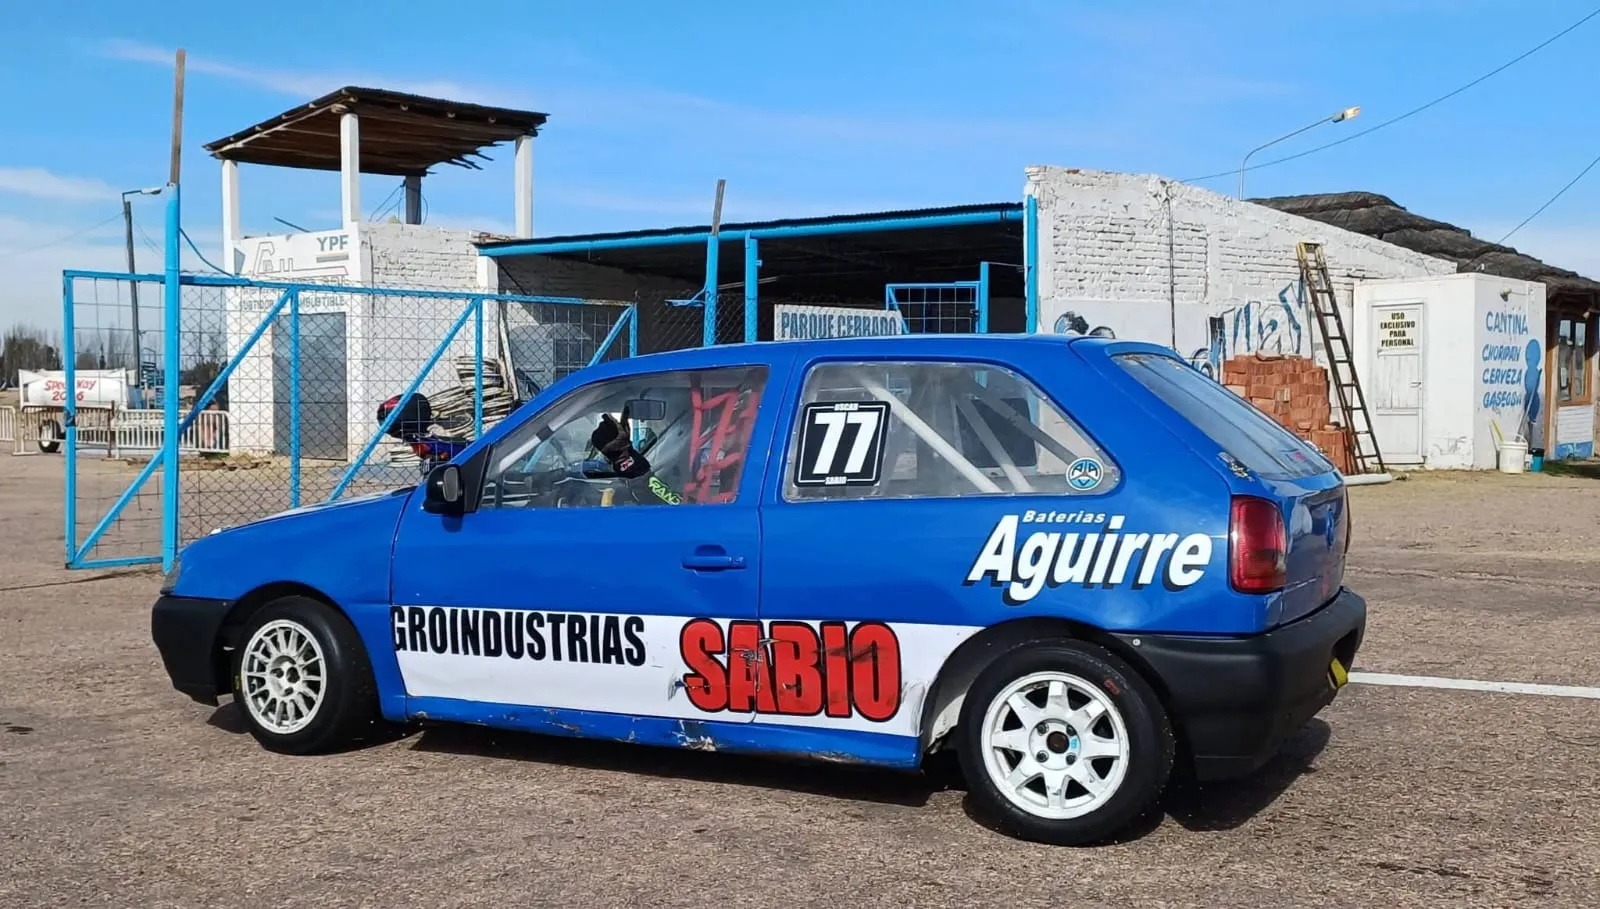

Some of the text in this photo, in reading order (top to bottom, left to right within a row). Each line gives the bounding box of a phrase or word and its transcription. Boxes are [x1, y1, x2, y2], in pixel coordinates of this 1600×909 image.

[317, 235, 349, 252] YPF
[1391, 312, 1405, 320] USO
[1486, 311, 1528, 335] CANTINA
[781, 312, 897, 338] PARQUE CERRADO
[1380, 321, 1416, 329] EXCLUSIVO
[1381, 338, 1415, 347] PERSONAL
[1389, 330, 1407, 338] PARA
[1482, 344, 1521, 361] CHORIPAN
[1482, 368, 1522, 385] CERVEZA
[52, 391, 85, 402] 206
[812, 411, 880, 475] 77
[1022, 510, 1106, 523] Baterias
[966, 514, 1213, 602] Aguirre
[391, 607, 903, 722] GROINDUSTRIAS SABIO
